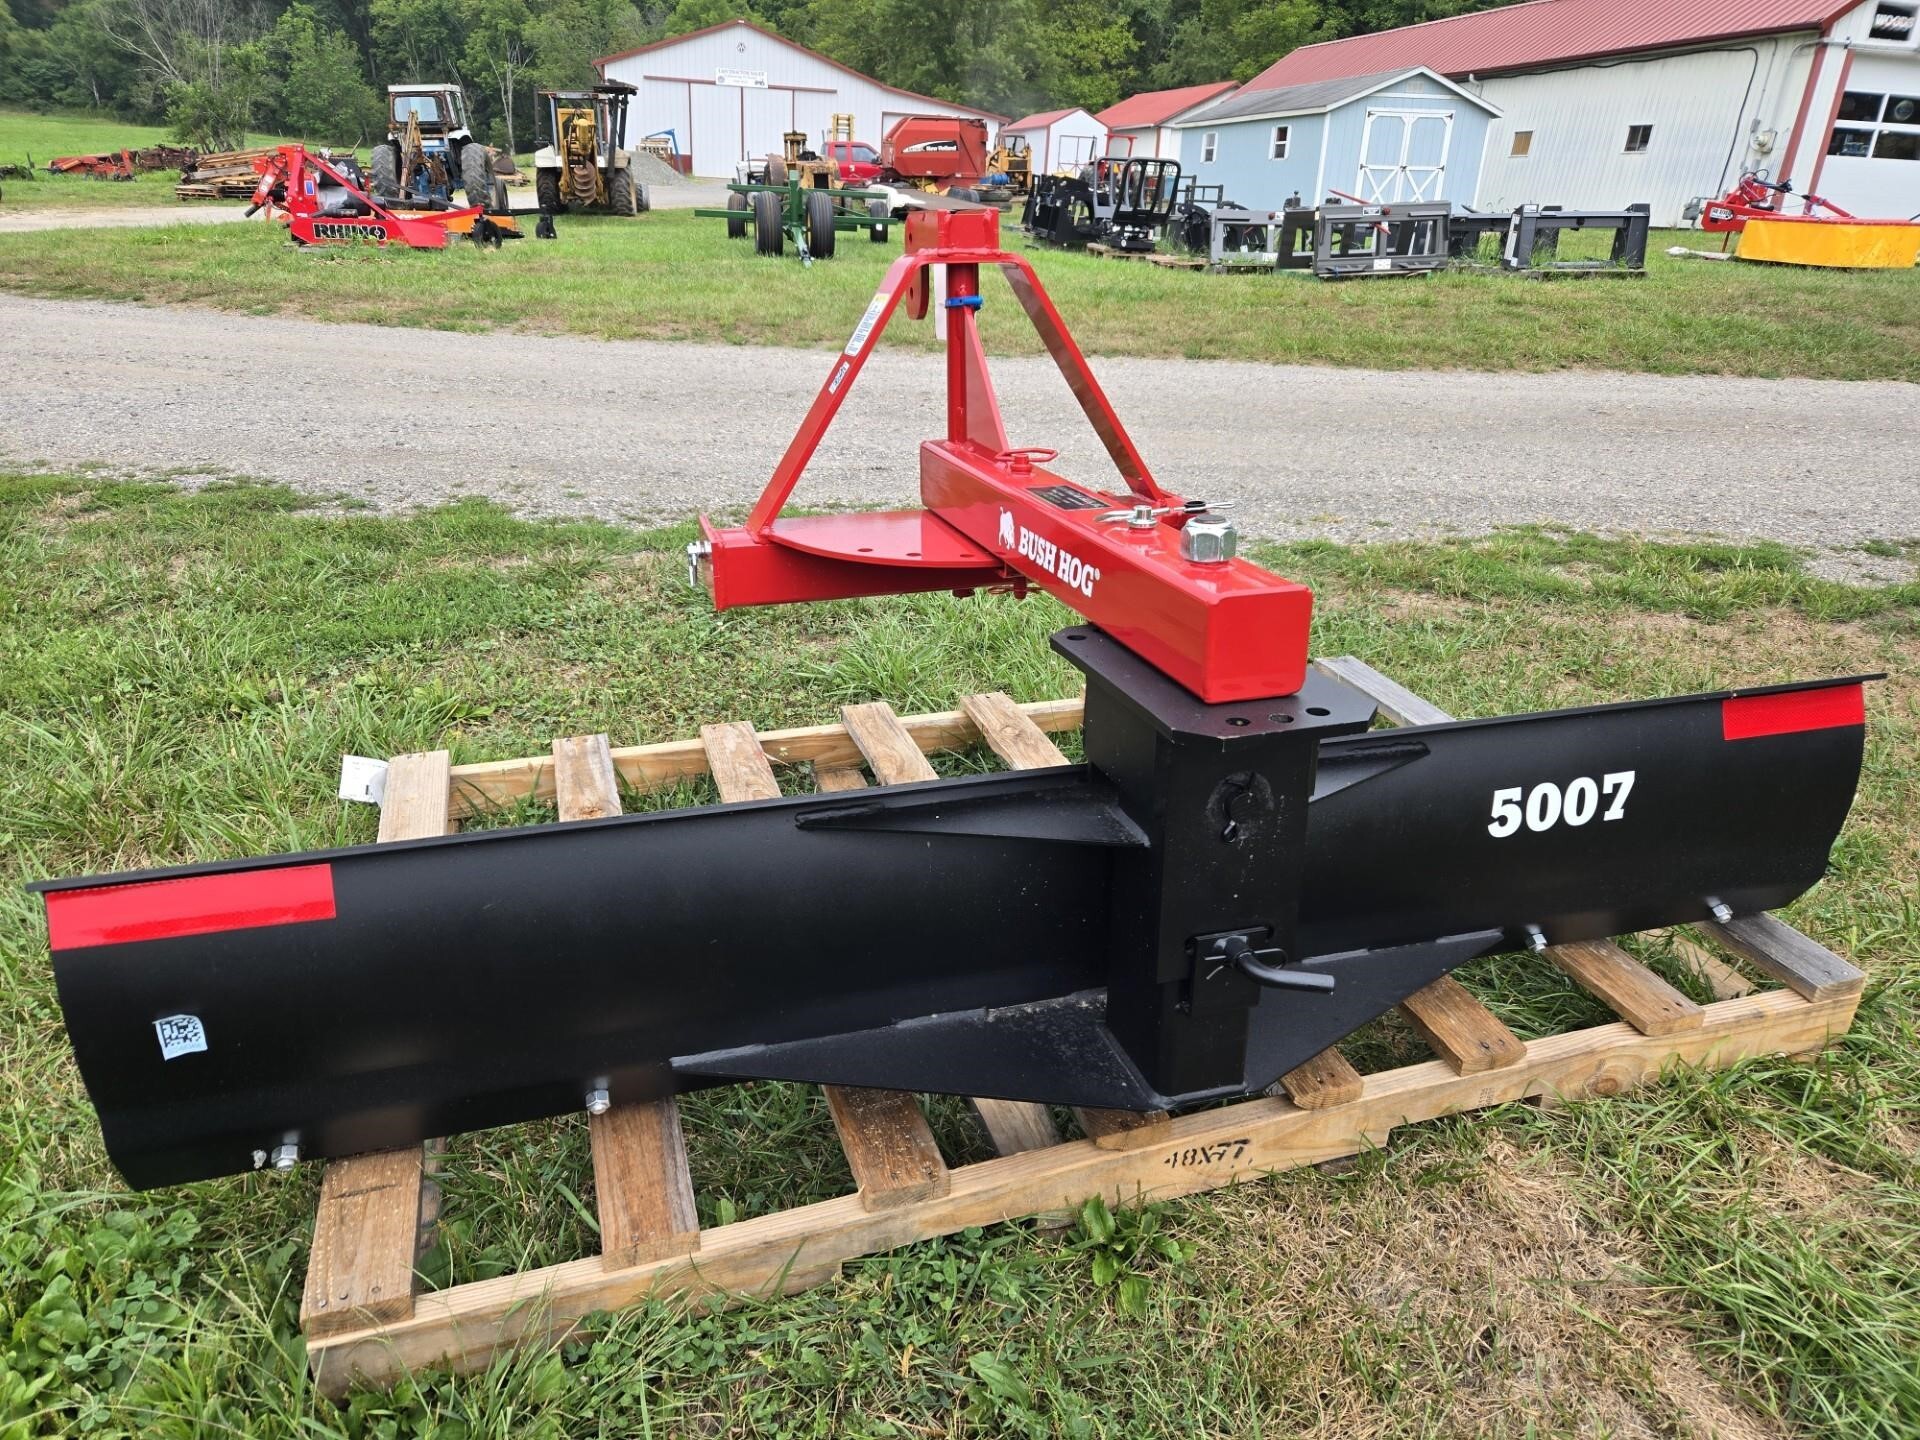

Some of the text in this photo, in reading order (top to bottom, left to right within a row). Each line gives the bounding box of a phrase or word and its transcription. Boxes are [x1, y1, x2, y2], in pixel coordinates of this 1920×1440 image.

[313, 223, 388, 241] RHINO
[1018, 526, 1057, 567] BUSH
[1487, 770, 1636, 838] 5007
